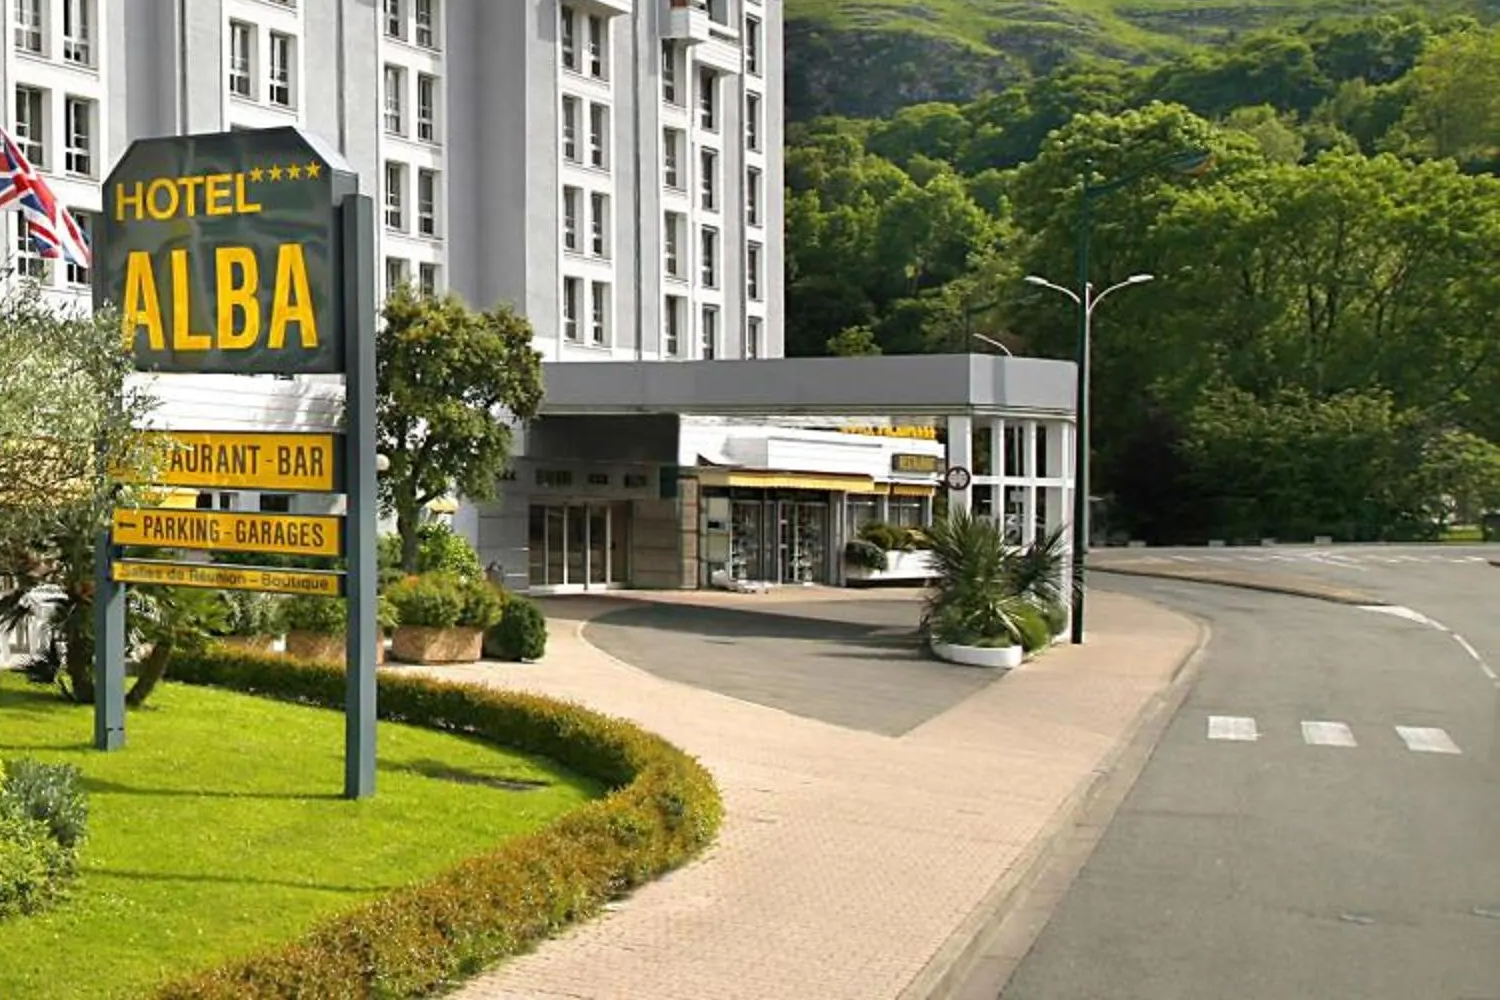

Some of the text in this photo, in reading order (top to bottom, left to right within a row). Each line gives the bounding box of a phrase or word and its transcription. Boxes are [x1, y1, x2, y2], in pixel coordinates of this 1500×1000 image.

[115, 172, 262, 221] HOTEL
[121, 242, 319, 351] ALBA
[277, 445, 324, 477] BAR
[142, 514, 221, 542] PARKING
[235, 519, 324, 547] GARAGES
